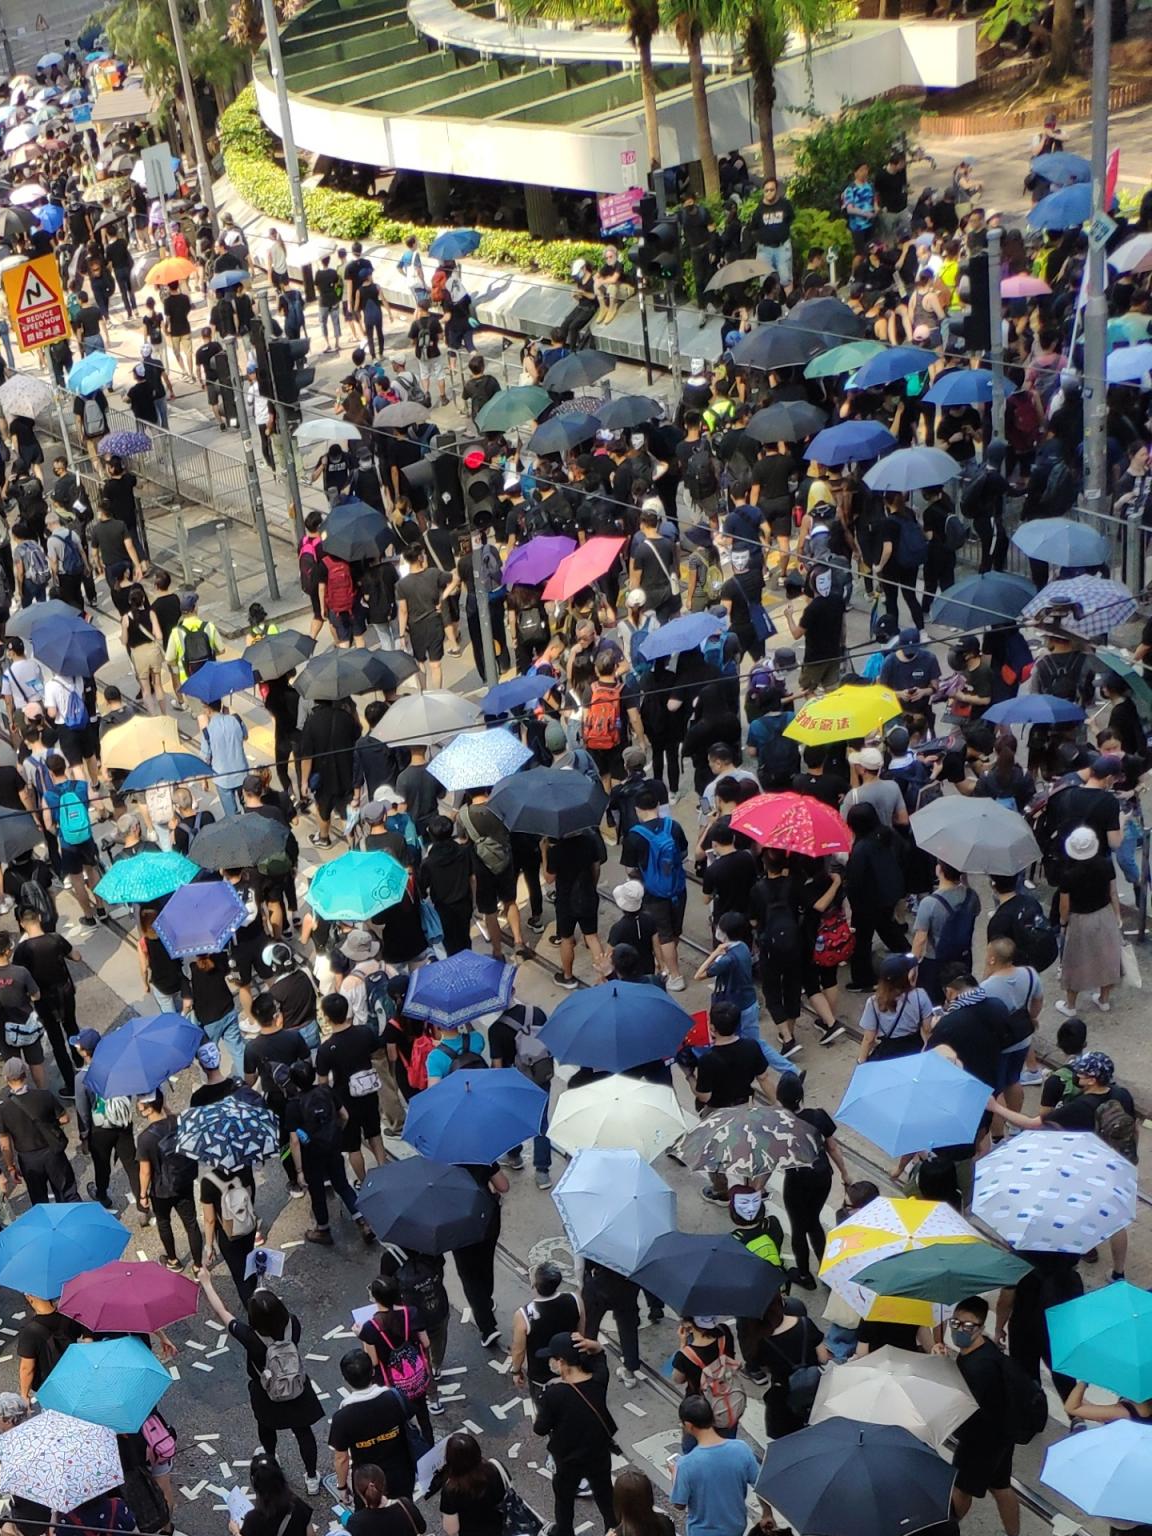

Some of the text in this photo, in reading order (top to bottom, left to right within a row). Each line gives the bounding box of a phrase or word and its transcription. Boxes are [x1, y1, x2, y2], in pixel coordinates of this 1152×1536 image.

[22, 315, 61, 333] SPEED NOW
[26, 310, 54, 323] REDUCE
